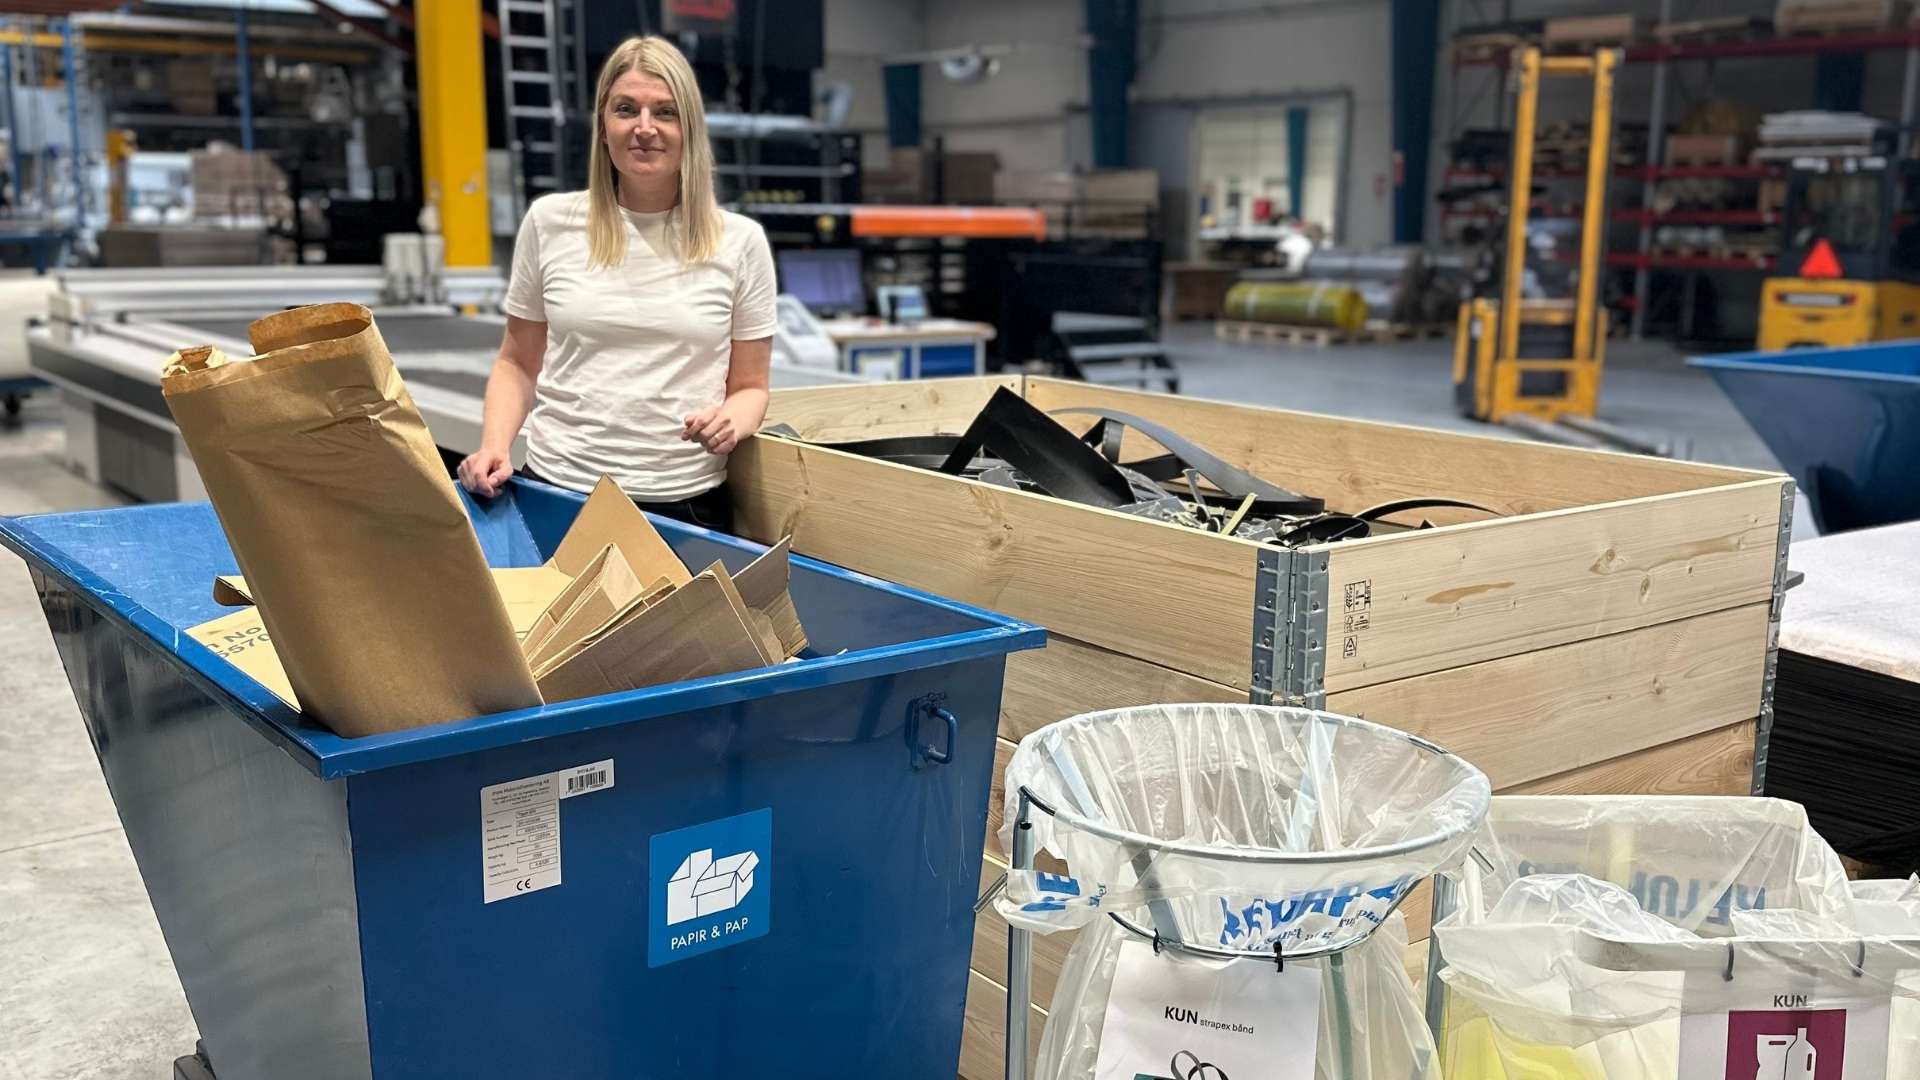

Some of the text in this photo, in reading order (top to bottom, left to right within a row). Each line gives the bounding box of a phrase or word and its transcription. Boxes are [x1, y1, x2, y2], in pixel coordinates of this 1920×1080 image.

[671, 917, 749, 950] PAPIR & PAP
[1773, 994, 1808, 1008] KUN
[1164, 1005, 1254, 1034] KUN strapex bånd
